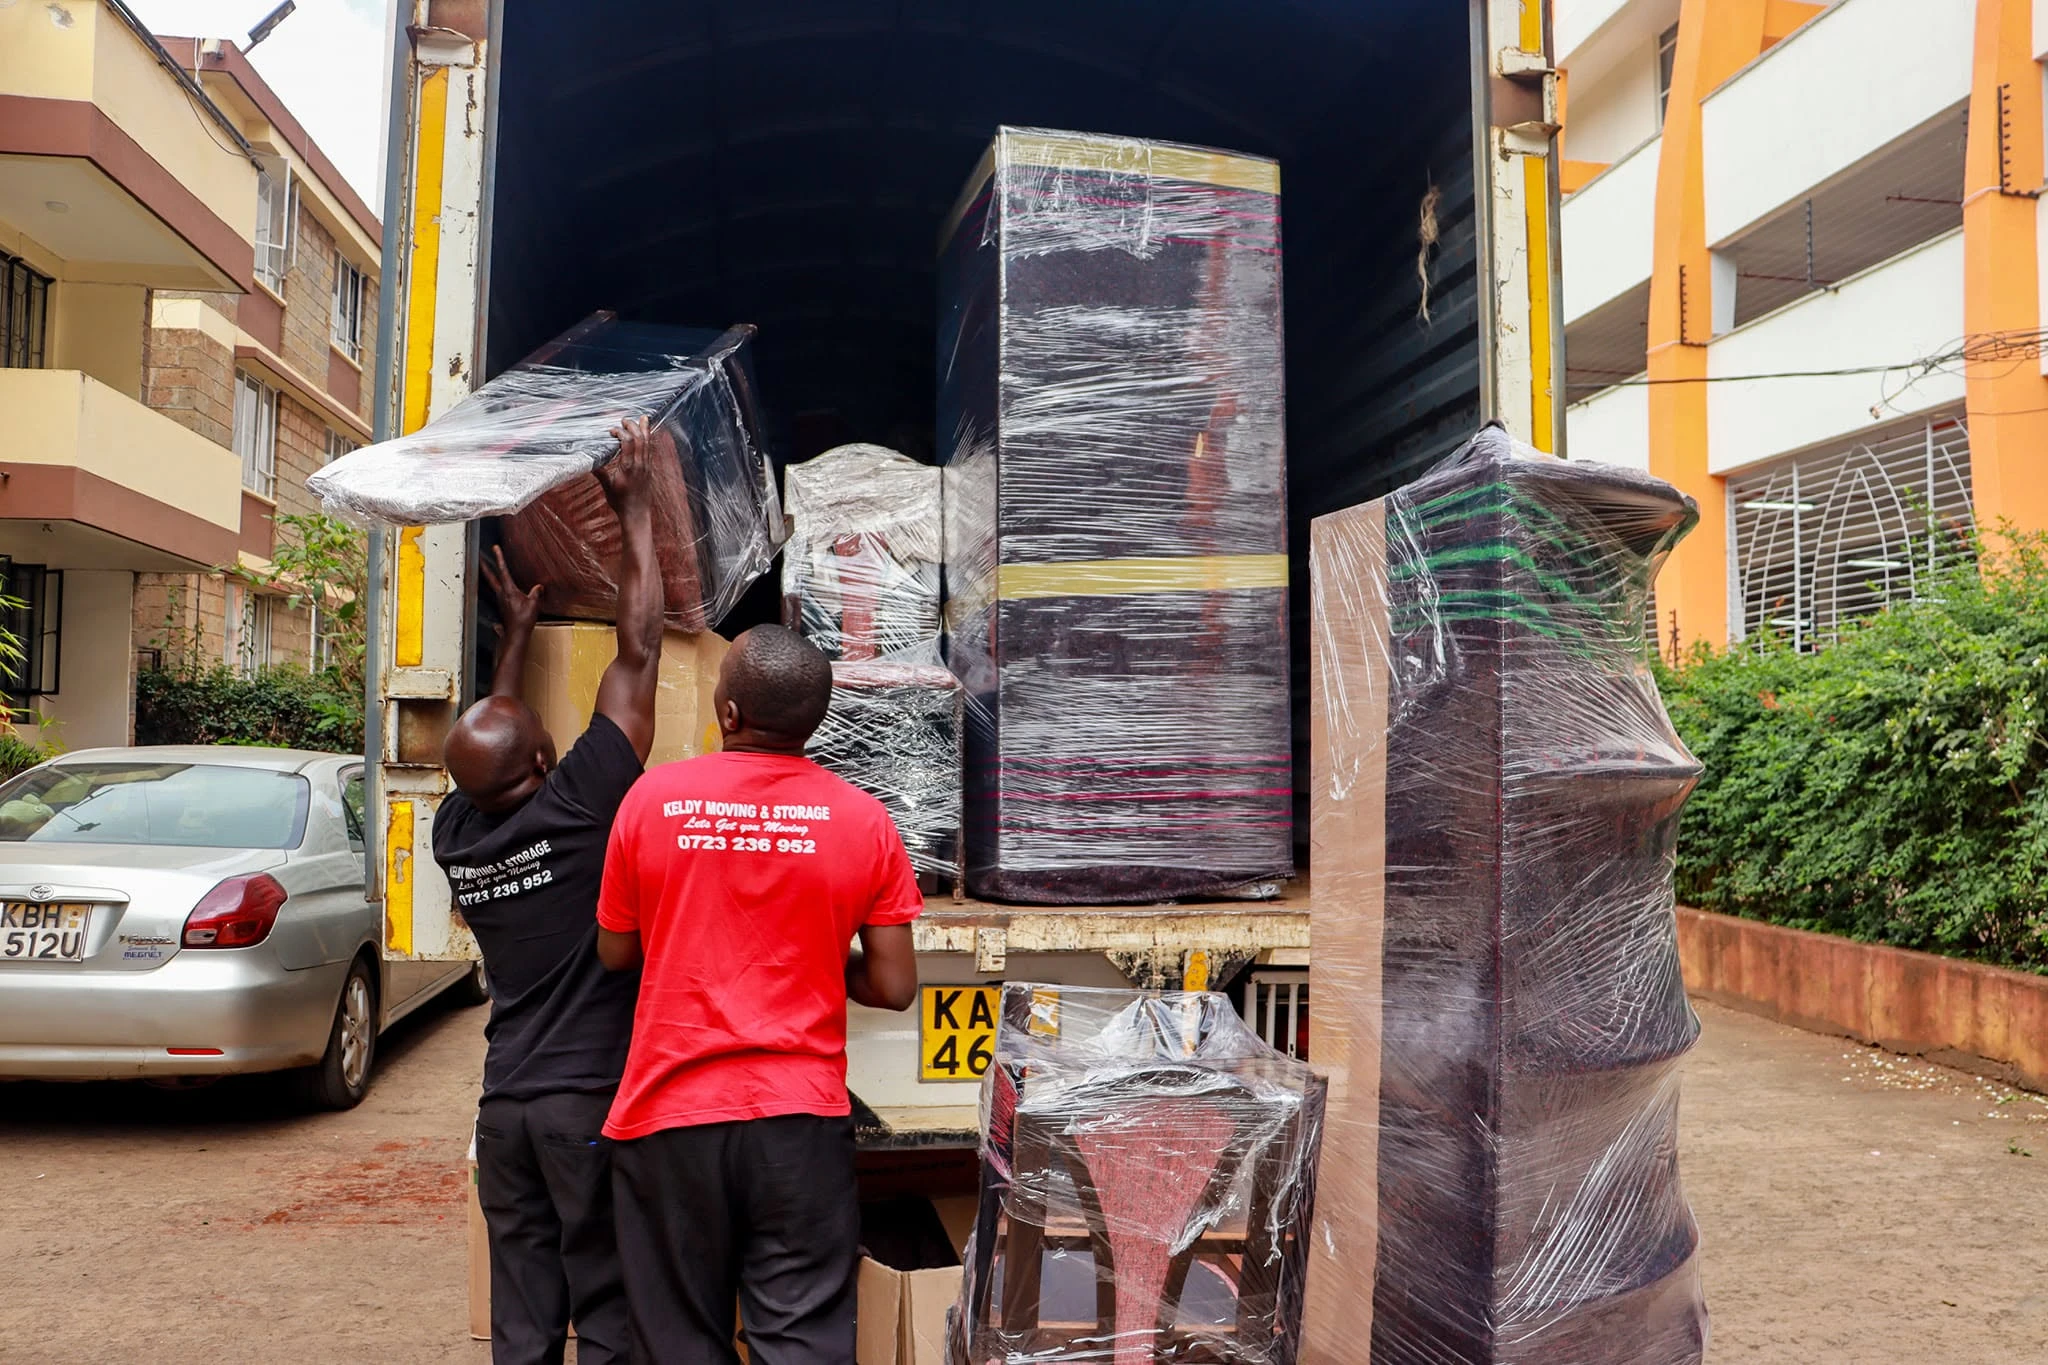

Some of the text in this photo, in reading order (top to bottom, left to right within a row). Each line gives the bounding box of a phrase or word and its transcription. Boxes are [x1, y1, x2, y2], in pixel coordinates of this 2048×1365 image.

[663, 800, 831, 821] KELDY MOVING & STORAGE
[683, 816, 809, 837] Lets Get you Moving
[677, 835, 816, 854] 0723 236 952
[465, 864, 498, 879] MOVING
[497, 862, 507, 871] &
[505, 840, 552, 868] STORAGE
[458, 860, 541, 890] Lets Get you Moving
[459, 870, 553, 906] 0723 236 952
[1, 903, 63, 928] KBH
[4, 931, 82, 959] 512U
[934, 990, 1003, 1030] KA
